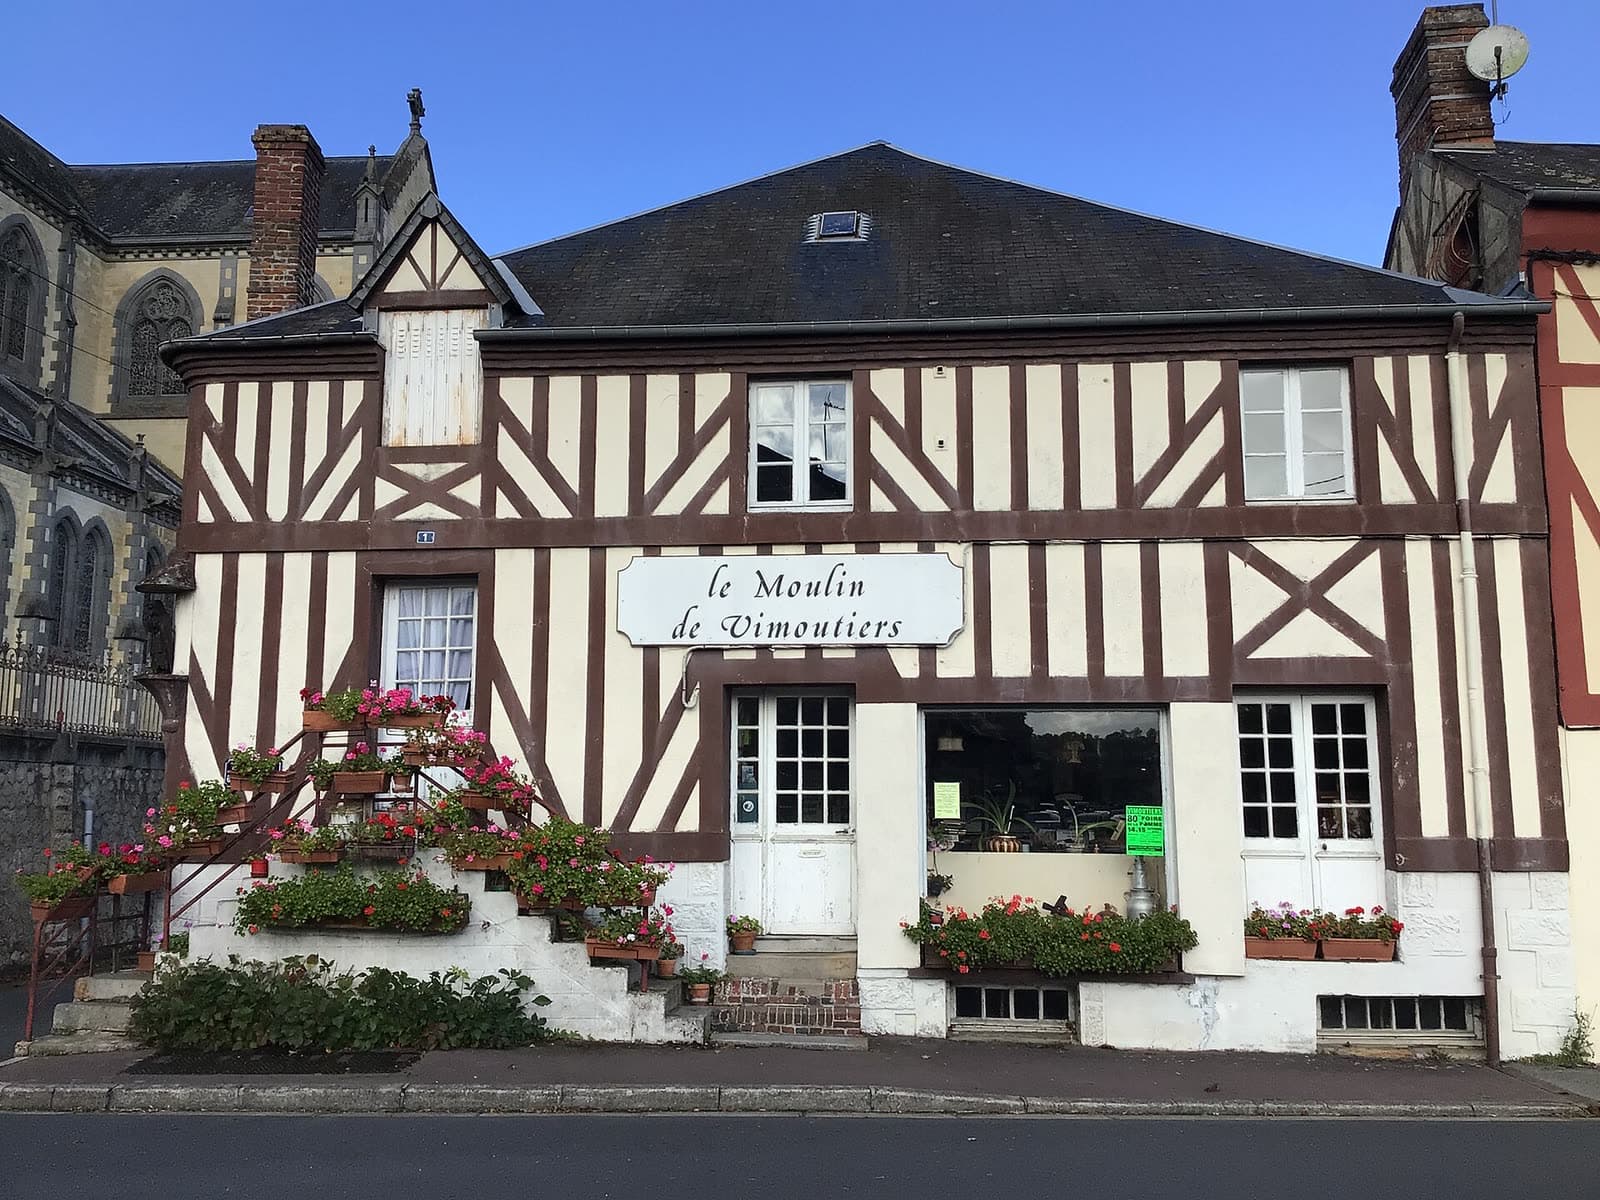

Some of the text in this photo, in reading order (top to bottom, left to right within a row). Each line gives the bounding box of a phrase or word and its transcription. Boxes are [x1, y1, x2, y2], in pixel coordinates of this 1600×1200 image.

[708, 563, 865, 598] le Moulin
[671, 605, 903, 639] de Vimoutiers
